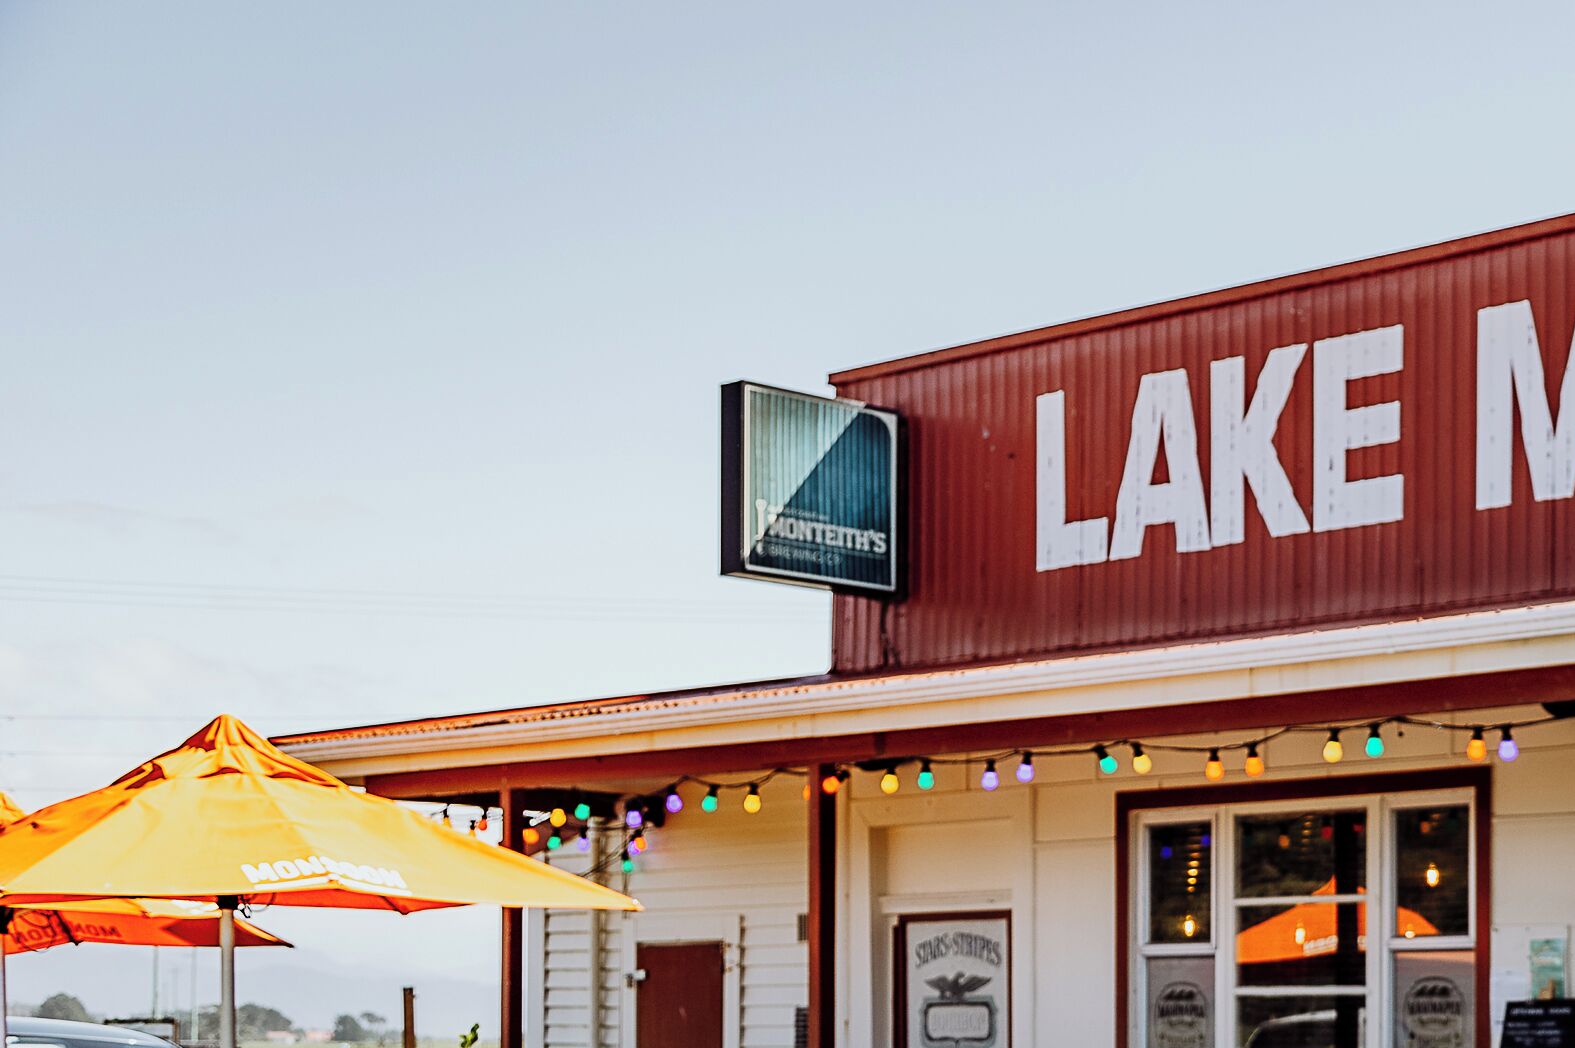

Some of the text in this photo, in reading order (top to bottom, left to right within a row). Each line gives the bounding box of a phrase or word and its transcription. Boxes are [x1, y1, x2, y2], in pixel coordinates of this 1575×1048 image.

[1036, 324, 1404, 571] LAKE
[768, 516, 887, 554] MONTEITH'S
[240, 855, 408, 890] MONSOON
[952, 931, 1002, 968] STRIPES
